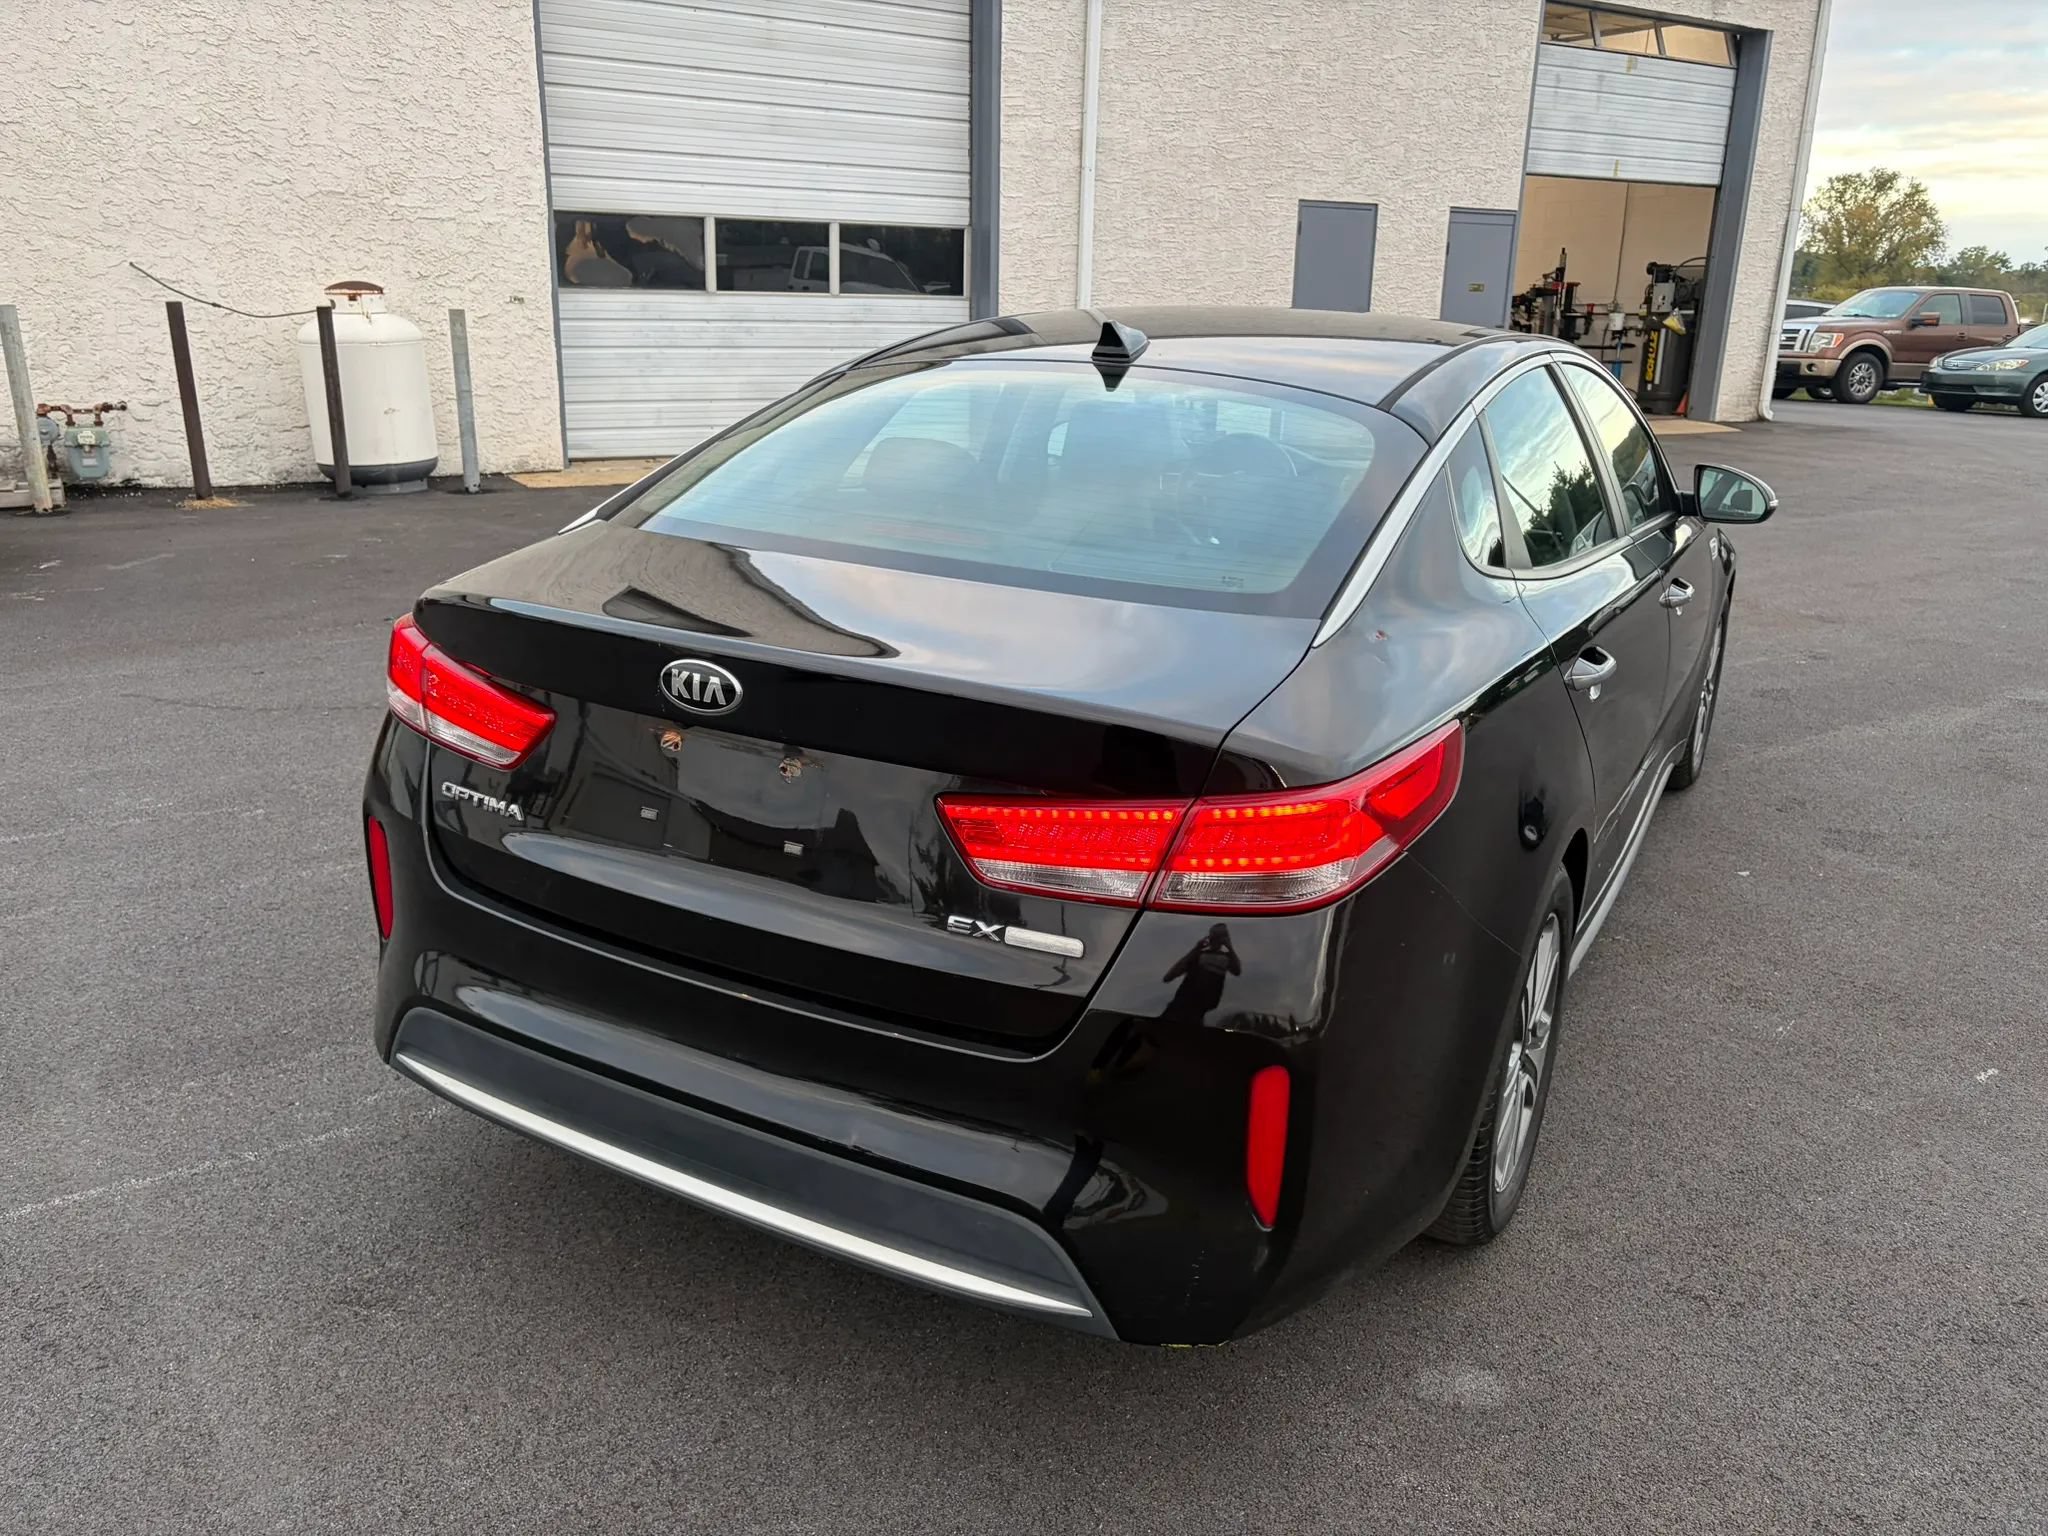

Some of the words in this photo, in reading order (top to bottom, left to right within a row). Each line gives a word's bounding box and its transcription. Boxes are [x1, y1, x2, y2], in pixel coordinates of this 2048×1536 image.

[671, 668, 726, 705] KIA
[442, 782, 524, 821] OPTIMA
[947, 915, 1004, 942] EX
